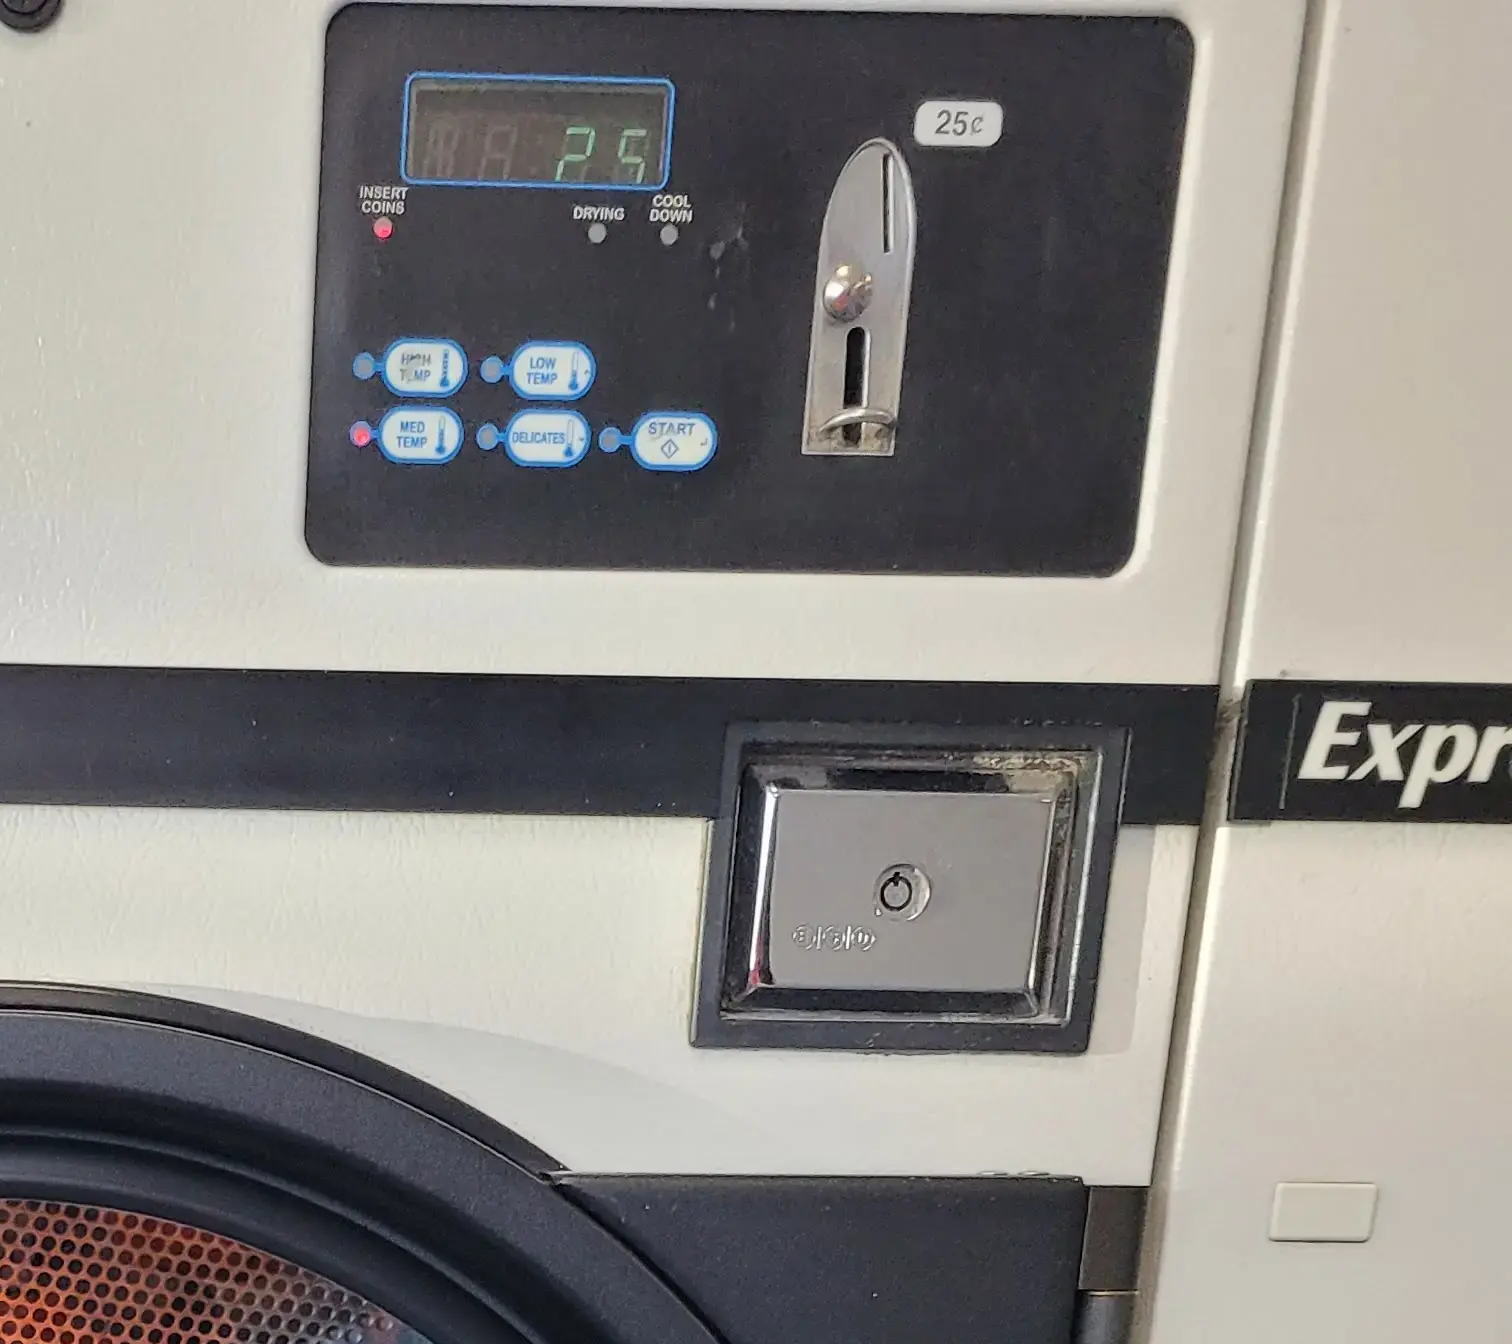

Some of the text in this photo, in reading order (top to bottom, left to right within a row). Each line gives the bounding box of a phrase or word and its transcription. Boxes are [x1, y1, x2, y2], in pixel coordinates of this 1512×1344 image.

[934, 109, 986, 136] 25¢
[359, 185, 409, 201] INSERT
[361, 200, 405, 216] COINS
[652, 194, 692, 209] COOL
[572, 205, 625, 222] DRYING
[649, 208, 693, 223] DOWN
[400, 353, 432, 366] HH
[529, 357, 557, 370] LOW
[399, 368, 431, 381] TMP
[526, 372, 558, 385] TEMP
[399, 420, 425, 433] MED
[648, 422, 696, 437] START
[396, 436, 428, 449] TEMP
[511, 431, 566, 445] DELICATES
[1297, 700, 1512, 809] Expr
